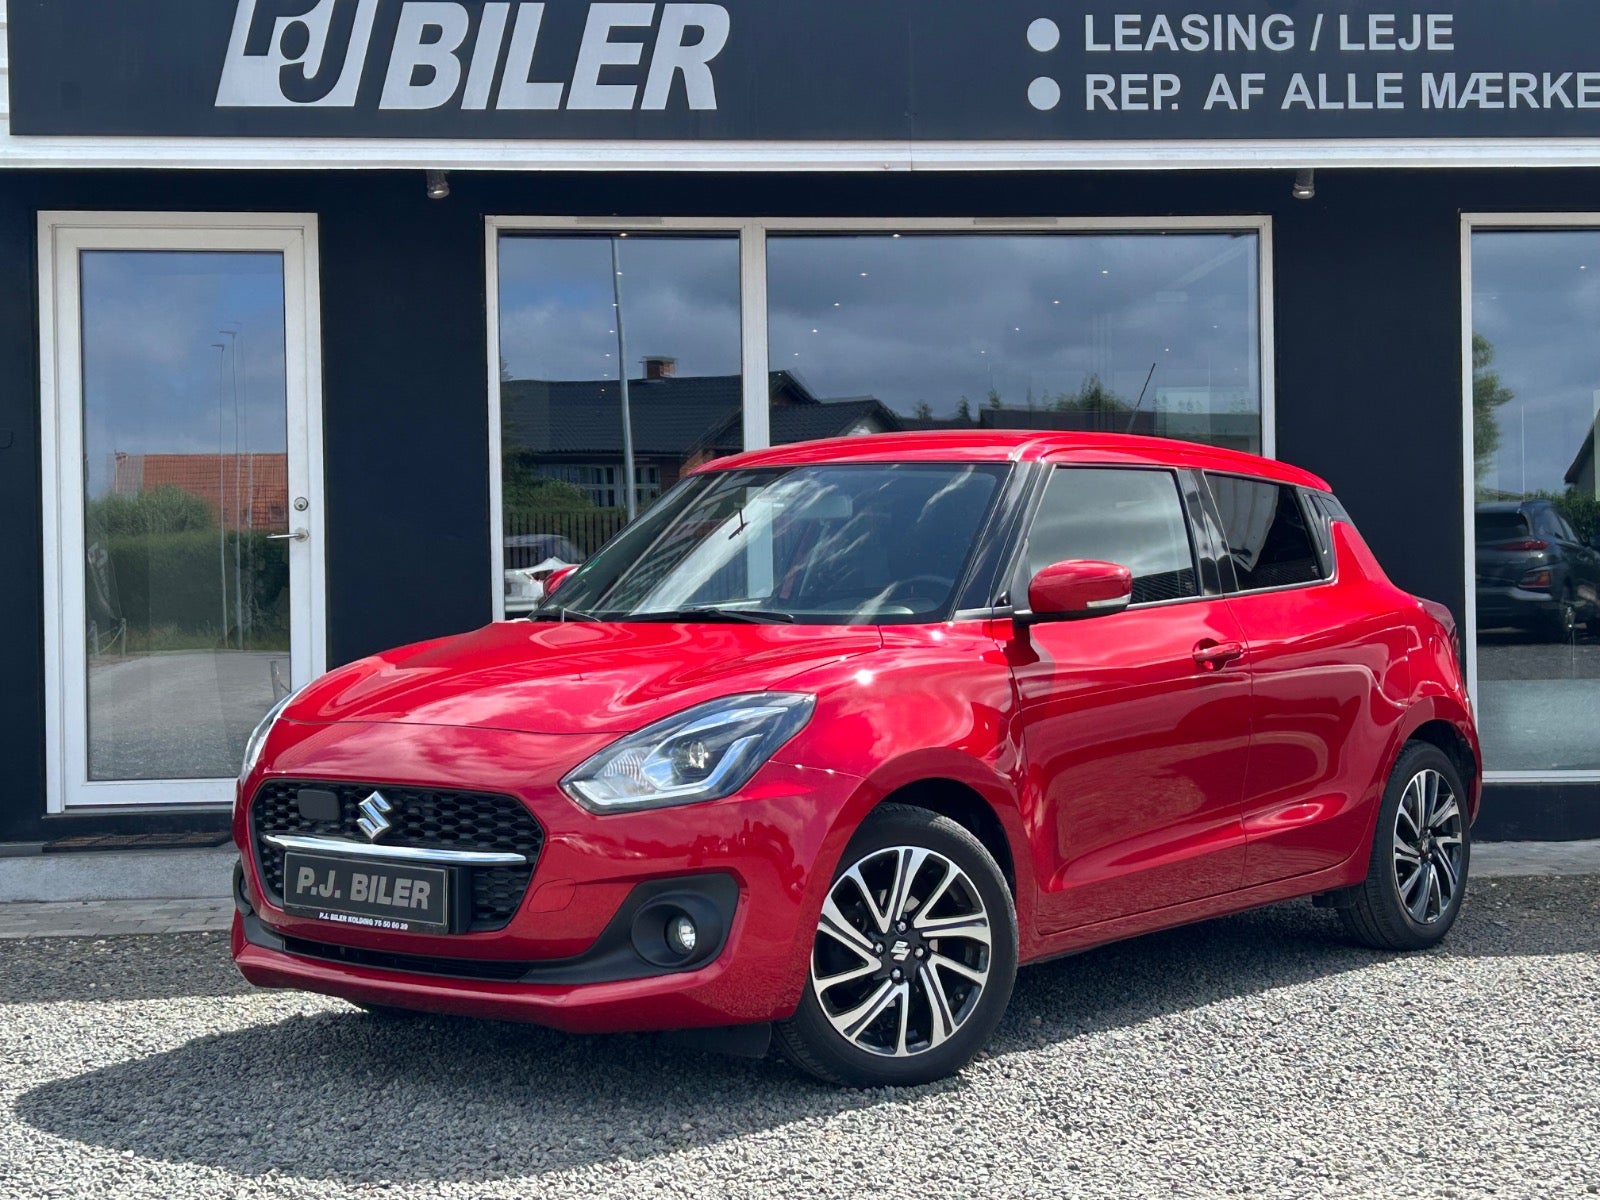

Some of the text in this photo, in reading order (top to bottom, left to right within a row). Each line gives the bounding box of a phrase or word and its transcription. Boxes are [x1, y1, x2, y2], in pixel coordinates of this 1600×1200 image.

[1085, 13, 1455, 51] LEASING / LEJE
[378, 2, 731, 110] BILER
[1085, 73, 1181, 111] REP.
[1203, 73, 1266, 109] AF
[1281, 73, 1404, 110] ALLE
[296, 866, 431, 910] P.J. BILER
[330, 913, 347, 922] BILER
[347, 916, 374, 926] KOLDING
